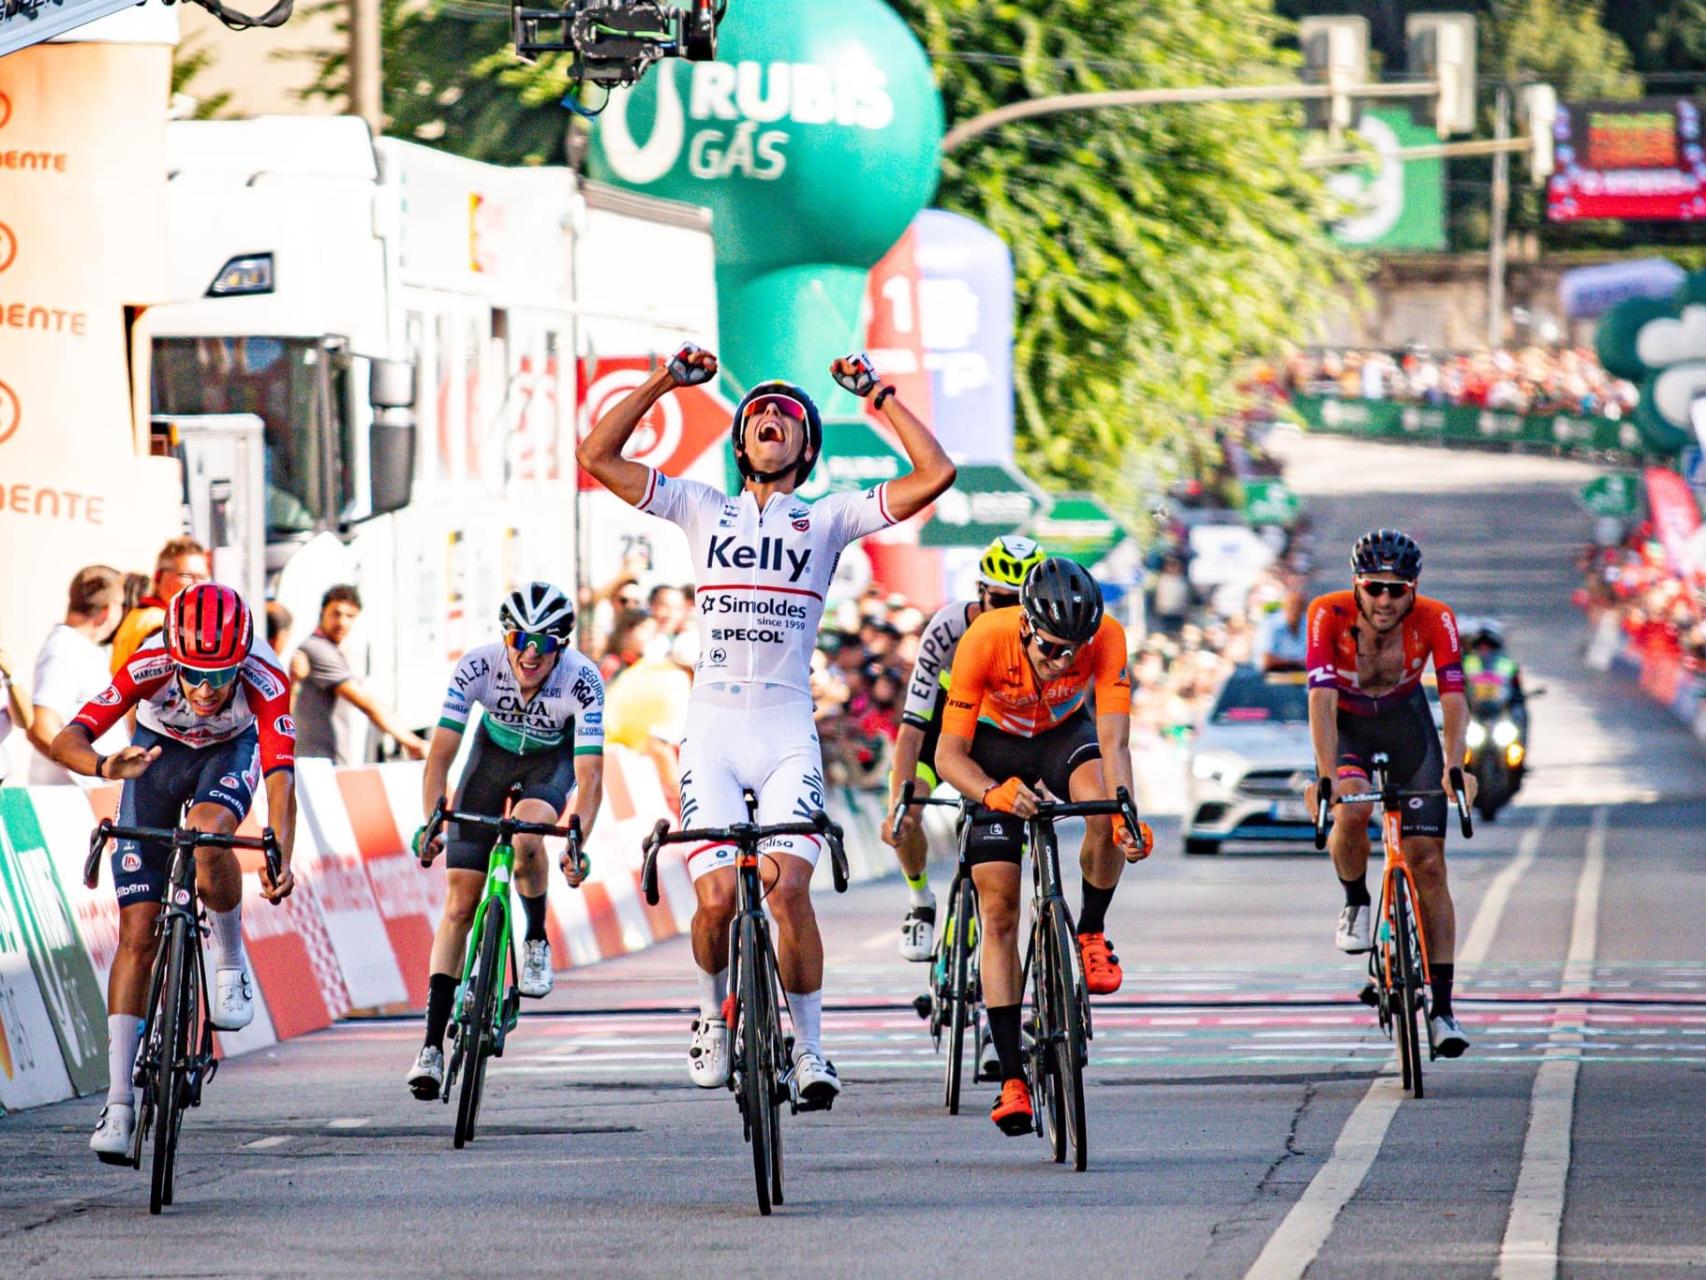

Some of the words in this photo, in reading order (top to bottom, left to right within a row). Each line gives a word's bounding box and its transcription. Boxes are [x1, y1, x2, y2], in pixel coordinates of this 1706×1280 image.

[689, 60, 894, 130] RUBIS
[0, 149, 67, 173] ENTE
[689, 120, 790, 181] GÁS
[0, 302, 88, 336] ENTE
[0, 482, 105, 525] ENTE
[707, 534, 812, 582] Kelly
[719, 594, 807, 619] Simoldes
[757, 616, 782, 627] since
[785, 619, 805, 630] 1959
[723, 628, 784, 643] PECOL
[133, 668, 163, 681] MARCOS
[454, 657, 490, 692] ALEA
[911, 621, 959, 700] EFAPEL
[571, 679, 595, 709] RGA
